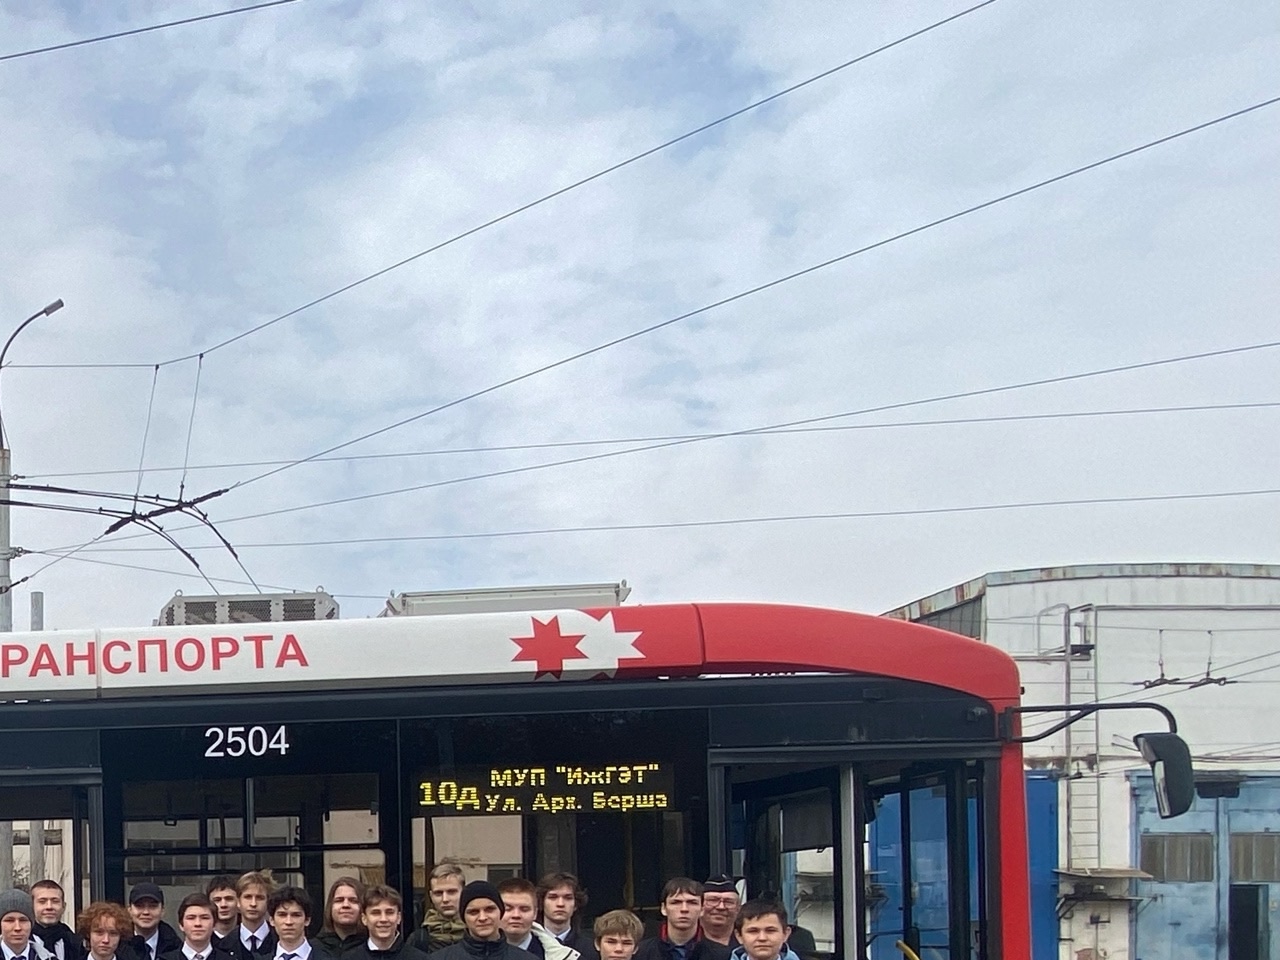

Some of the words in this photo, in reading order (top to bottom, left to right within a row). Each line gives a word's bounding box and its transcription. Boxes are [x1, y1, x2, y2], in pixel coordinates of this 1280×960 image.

[204, 725, 290, 758] 2504
[490, 768, 546, 787] МУП
[556, 763, 659, 785] "ИжГЭТ"
[484, 794, 522, 812] Ул.
[532, 792, 583, 814] Арх.
